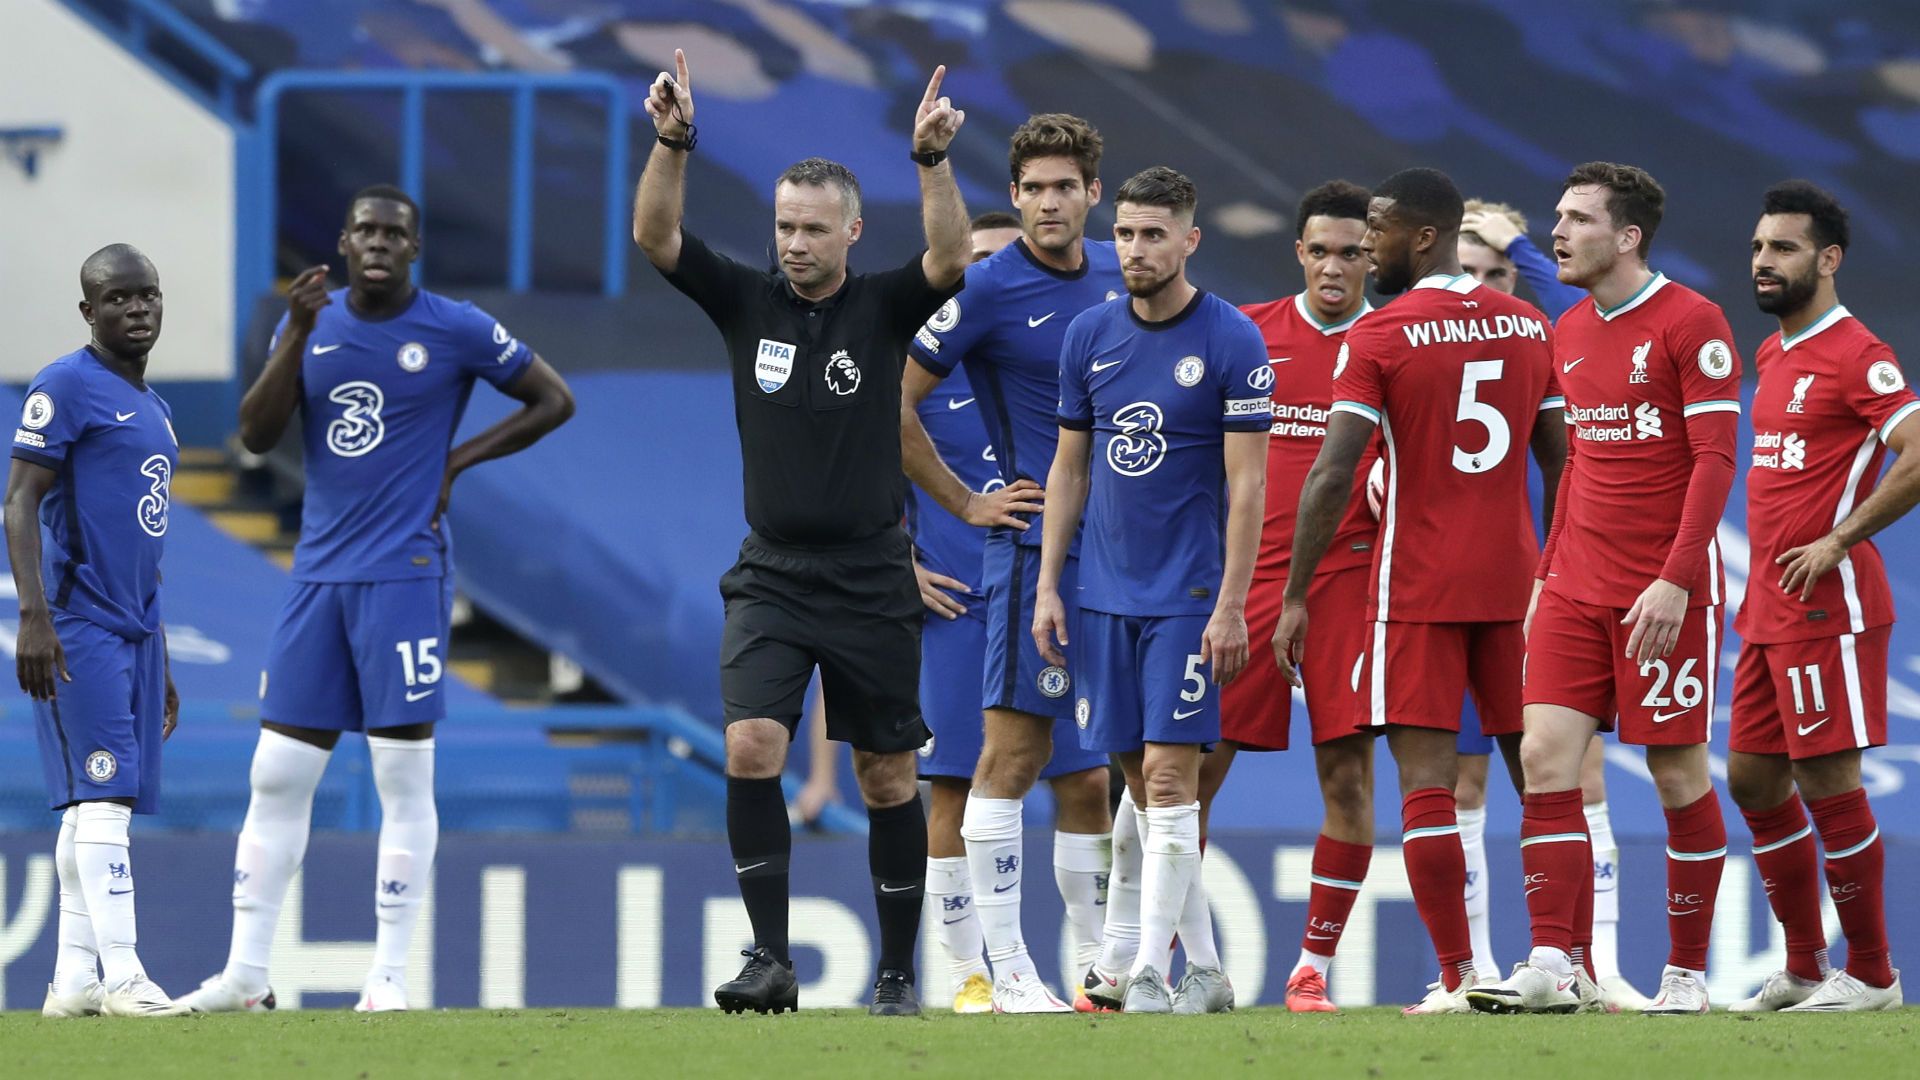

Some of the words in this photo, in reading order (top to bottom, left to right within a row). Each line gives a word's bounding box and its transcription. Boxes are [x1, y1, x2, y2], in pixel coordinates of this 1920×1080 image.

[761, 343, 791, 360] FIFA
[1403, 315, 1547, 348] WIJNALDUM
[758, 362, 788, 375] REFEREE
[762, 380, 778, 389] 2020
[1270, 401, 1330, 422] tandar
[1452, 359, 1511, 474] 5
[396, 637, 442, 687] 15
[1180, 654, 1206, 702] 5
[1639, 658, 1703, 708] 26
[1787, 664, 1825, 714] 11
